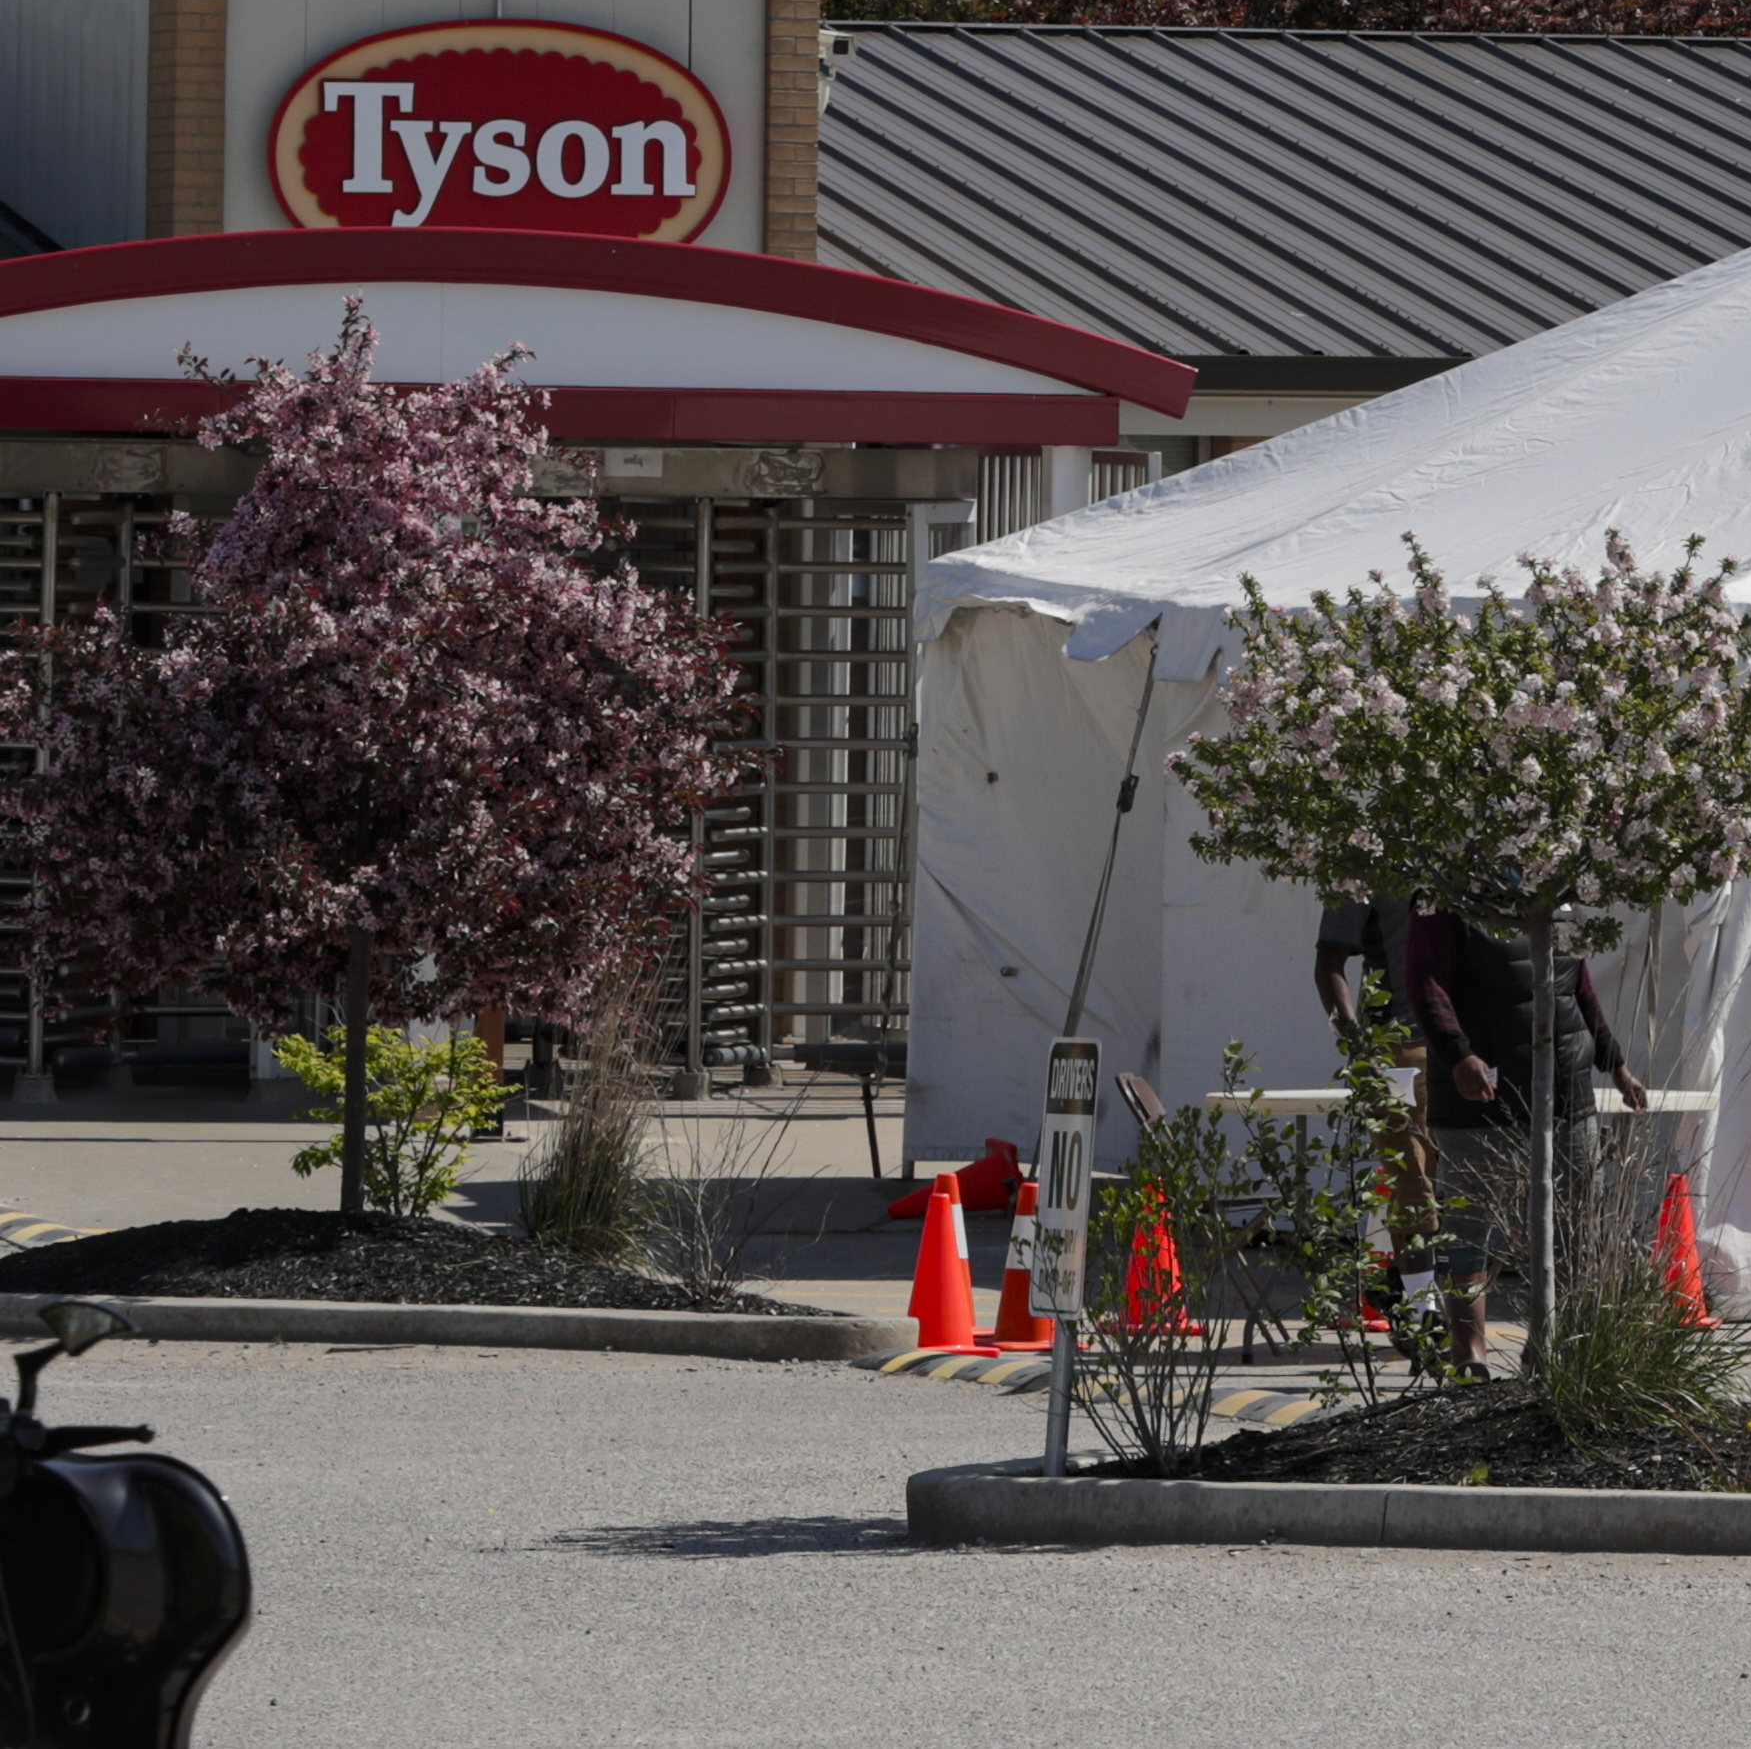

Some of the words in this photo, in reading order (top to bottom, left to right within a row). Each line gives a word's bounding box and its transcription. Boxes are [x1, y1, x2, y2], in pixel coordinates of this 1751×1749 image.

[323, 81, 697, 228] Tyson
[1050, 1058, 1095, 1101] DRIVERS
[1047, 1130, 1083, 1211] NO
[1038, 1268, 1076, 1295] D-OFF
